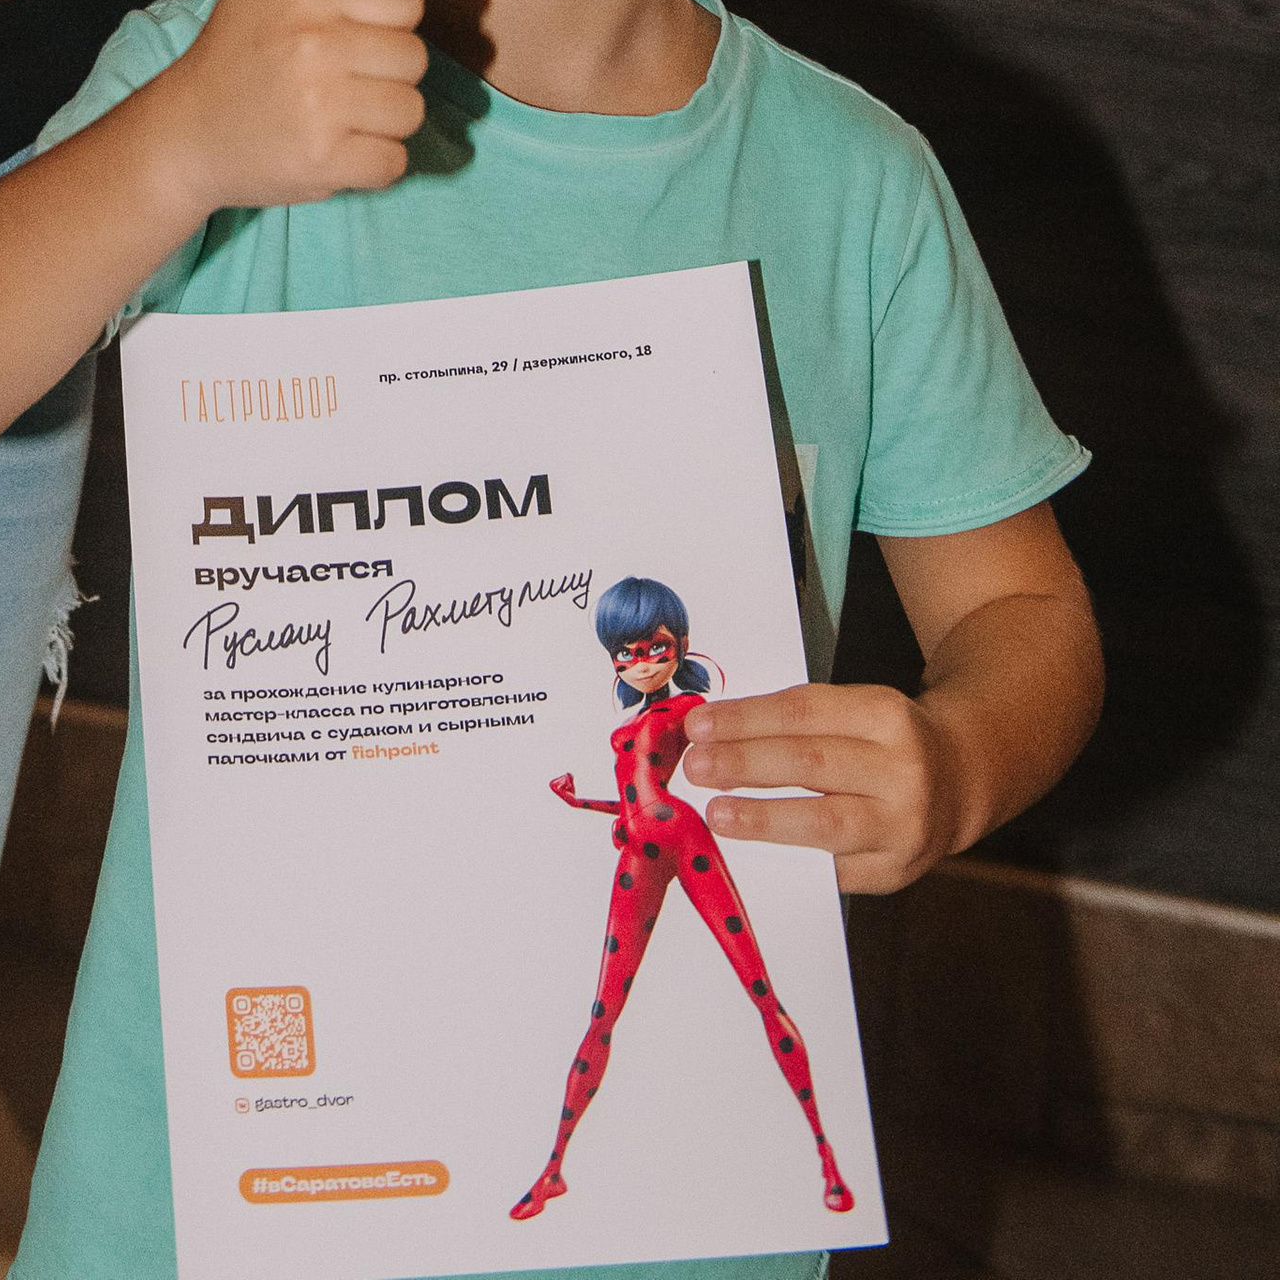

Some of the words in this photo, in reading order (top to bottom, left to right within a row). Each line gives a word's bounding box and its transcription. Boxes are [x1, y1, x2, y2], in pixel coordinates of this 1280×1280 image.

[379, 372, 401, 385] пр.
[405, 363, 488, 381] столыпина,
[492, 360, 508, 373] 29
[522, 348, 632, 372] дзержинского,
[635, 345, 653, 357] 18
[181, 375, 339, 423] ГАСТРОДВОР
[194, 559, 394, 591] вручается
[203, 688, 226, 701] за
[231, 683, 368, 705] прохождение
[372, 672, 504, 696] кулинарного
[204, 704, 355, 724] мастер-класса
[360, 703, 385, 717] по
[389, 690, 549, 717] приготовлению
[206, 728, 305, 746] сэндвича
[310, 728, 322, 740] с
[327, 723, 413, 743] судаком
[419, 722, 432, 734] и
[437, 712, 535, 733] сырными
[207, 749, 320, 766] палочками
[325, 749, 347, 761] от
[351, 740, 441, 761] fishpoint
[255, 1094, 354, 1112] gastro_dvor
